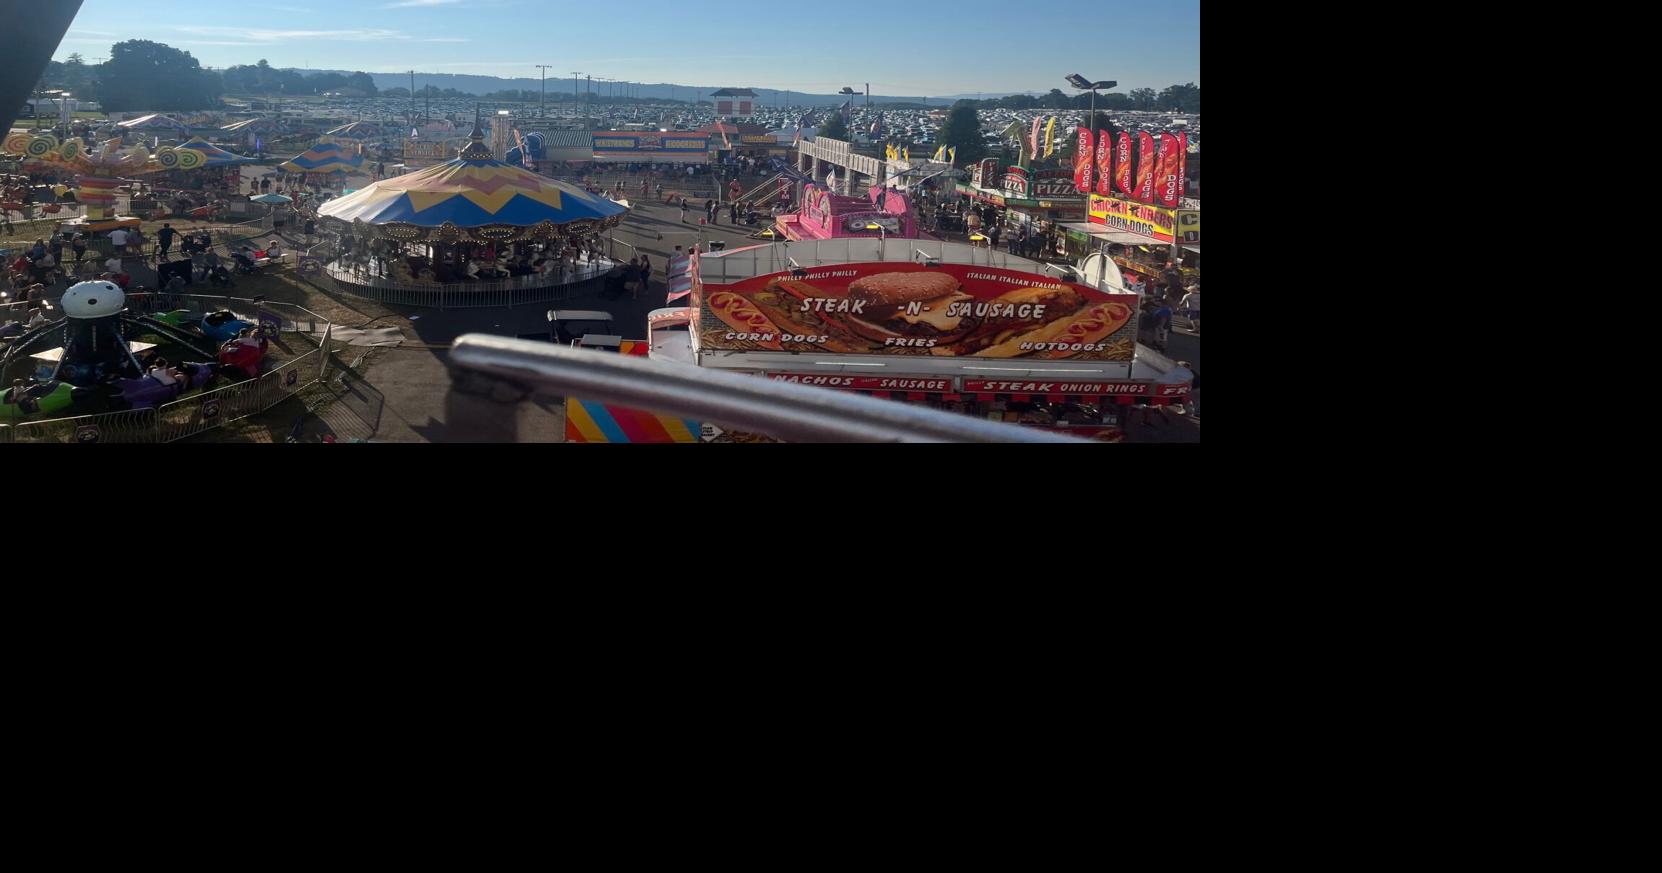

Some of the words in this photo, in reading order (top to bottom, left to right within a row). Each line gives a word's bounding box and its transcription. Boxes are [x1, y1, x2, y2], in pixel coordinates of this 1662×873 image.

[1079, 132, 1087, 157] CORN
[1097, 135, 1105, 160] CORN
[1119, 136, 1127, 163] CORN
[1082, 163, 1091, 187] DOGS
[1036, 184, 1081, 195] PIZZA
[1165, 174, 1177, 201] DOGS
[1105, 214, 1128, 231] CORN
[1129, 220, 1154, 236] DOGS
[804, 272, 829, 280] PHILLY
[967, 272, 997, 281] ITALIAN
[999, 276, 1029, 287] ITALIAN
[1031, 281, 1062, 290] ITALIAN
[800, 297, 867, 315] STEAK
[897, 301, 931, 316] -N-
[946, 302, 1046, 319] SAUSAGE
[725, 332, 774, 341] CORN
[781, 334, 828, 343] DOGS
[885, 337, 938, 347] FRIES
[1020, 342, 1106, 352] HOTDOGS
[774, 374, 854, 386] NACHOS
[880, 378, 946, 390] SAUSAGE
[984, 381, 1054, 393] STEAK
[1060, 384, 1102, 393] ONION
[1106, 384, 1146, 394] RINGS
